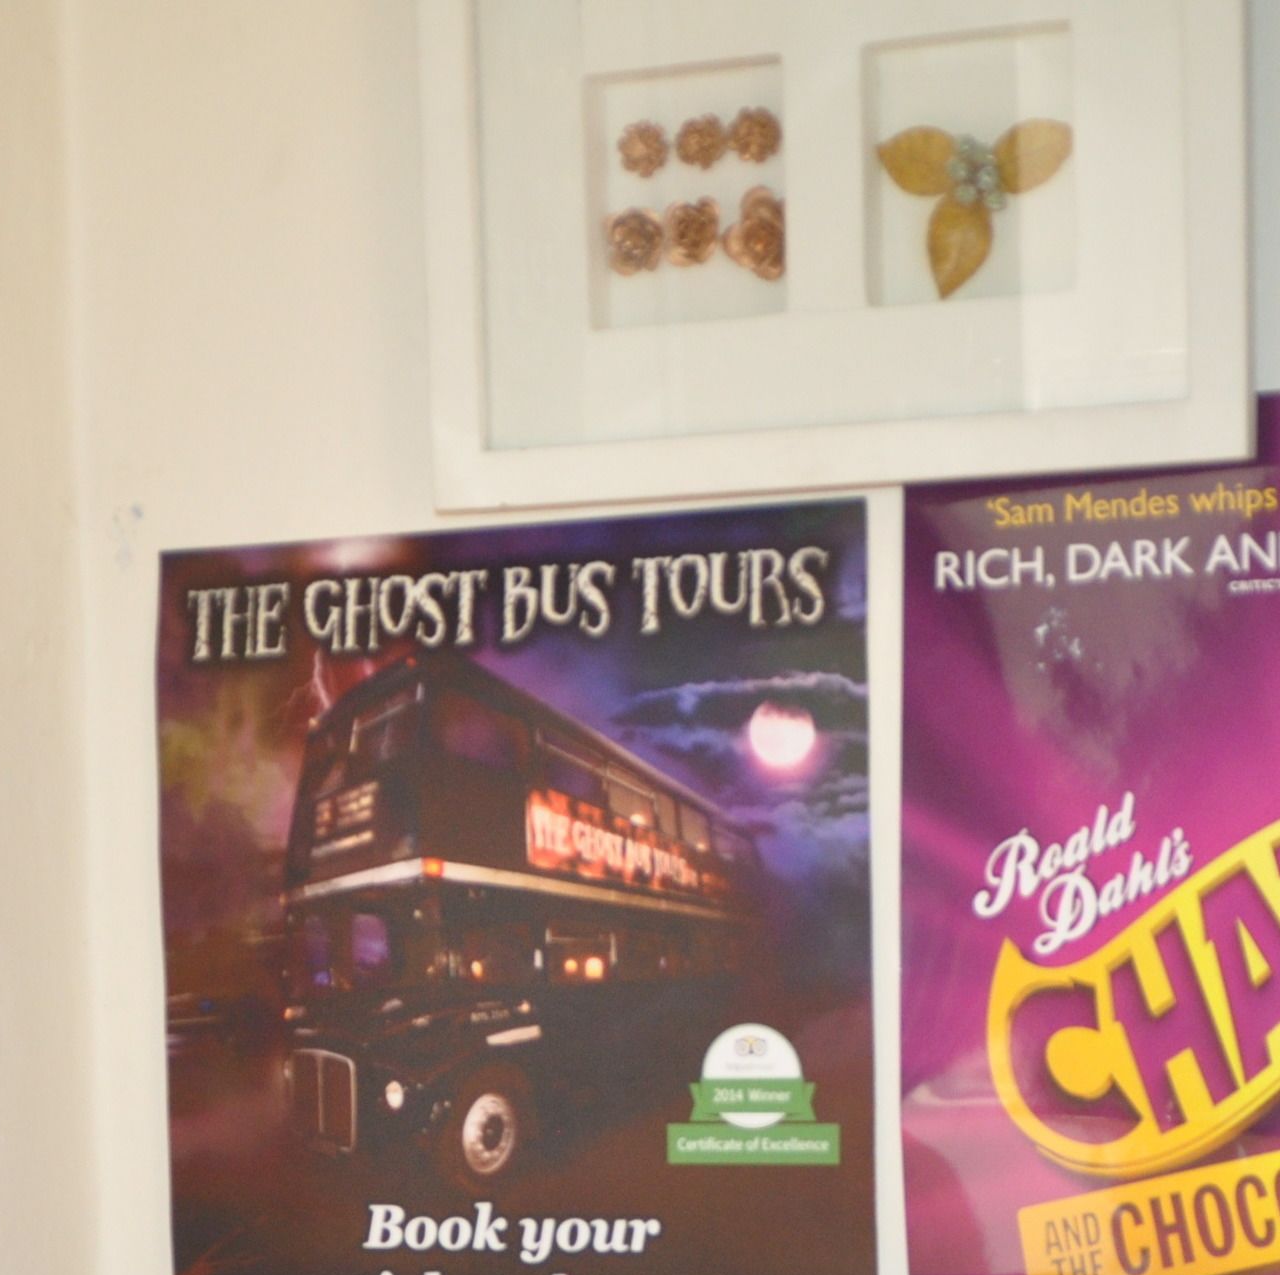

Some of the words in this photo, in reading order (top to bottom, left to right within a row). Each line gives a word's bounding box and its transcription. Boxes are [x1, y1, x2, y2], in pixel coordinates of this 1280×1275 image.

[1063, 490, 1180, 523] Mendes
[1191, 479, 1279, 524] whips
[935, 545, 1055, 592] RICH,
[1066, 536, 1194, 581] DARK
[188, 582, 289, 662] THE
[303, 569, 489, 654] GHOST
[501, 560, 615, 644] BUS
[633, 545, 829, 634] TOURS
[973, 791, 1136, 918] Roald
[1032, 827, 1193, 955] Dahl's
[713, 1088, 744, 1102] 2014
[748, 1088, 791, 1102] Winner
[676, 1136, 744, 1152] Certificate
[745, 1137, 759, 1151] of
[761, 1136, 830, 1152] Excellence
[362, 1202, 508, 1251] Book
[519, 1216, 662, 1264] your
[1045, 1212, 1101, 1256] AND
